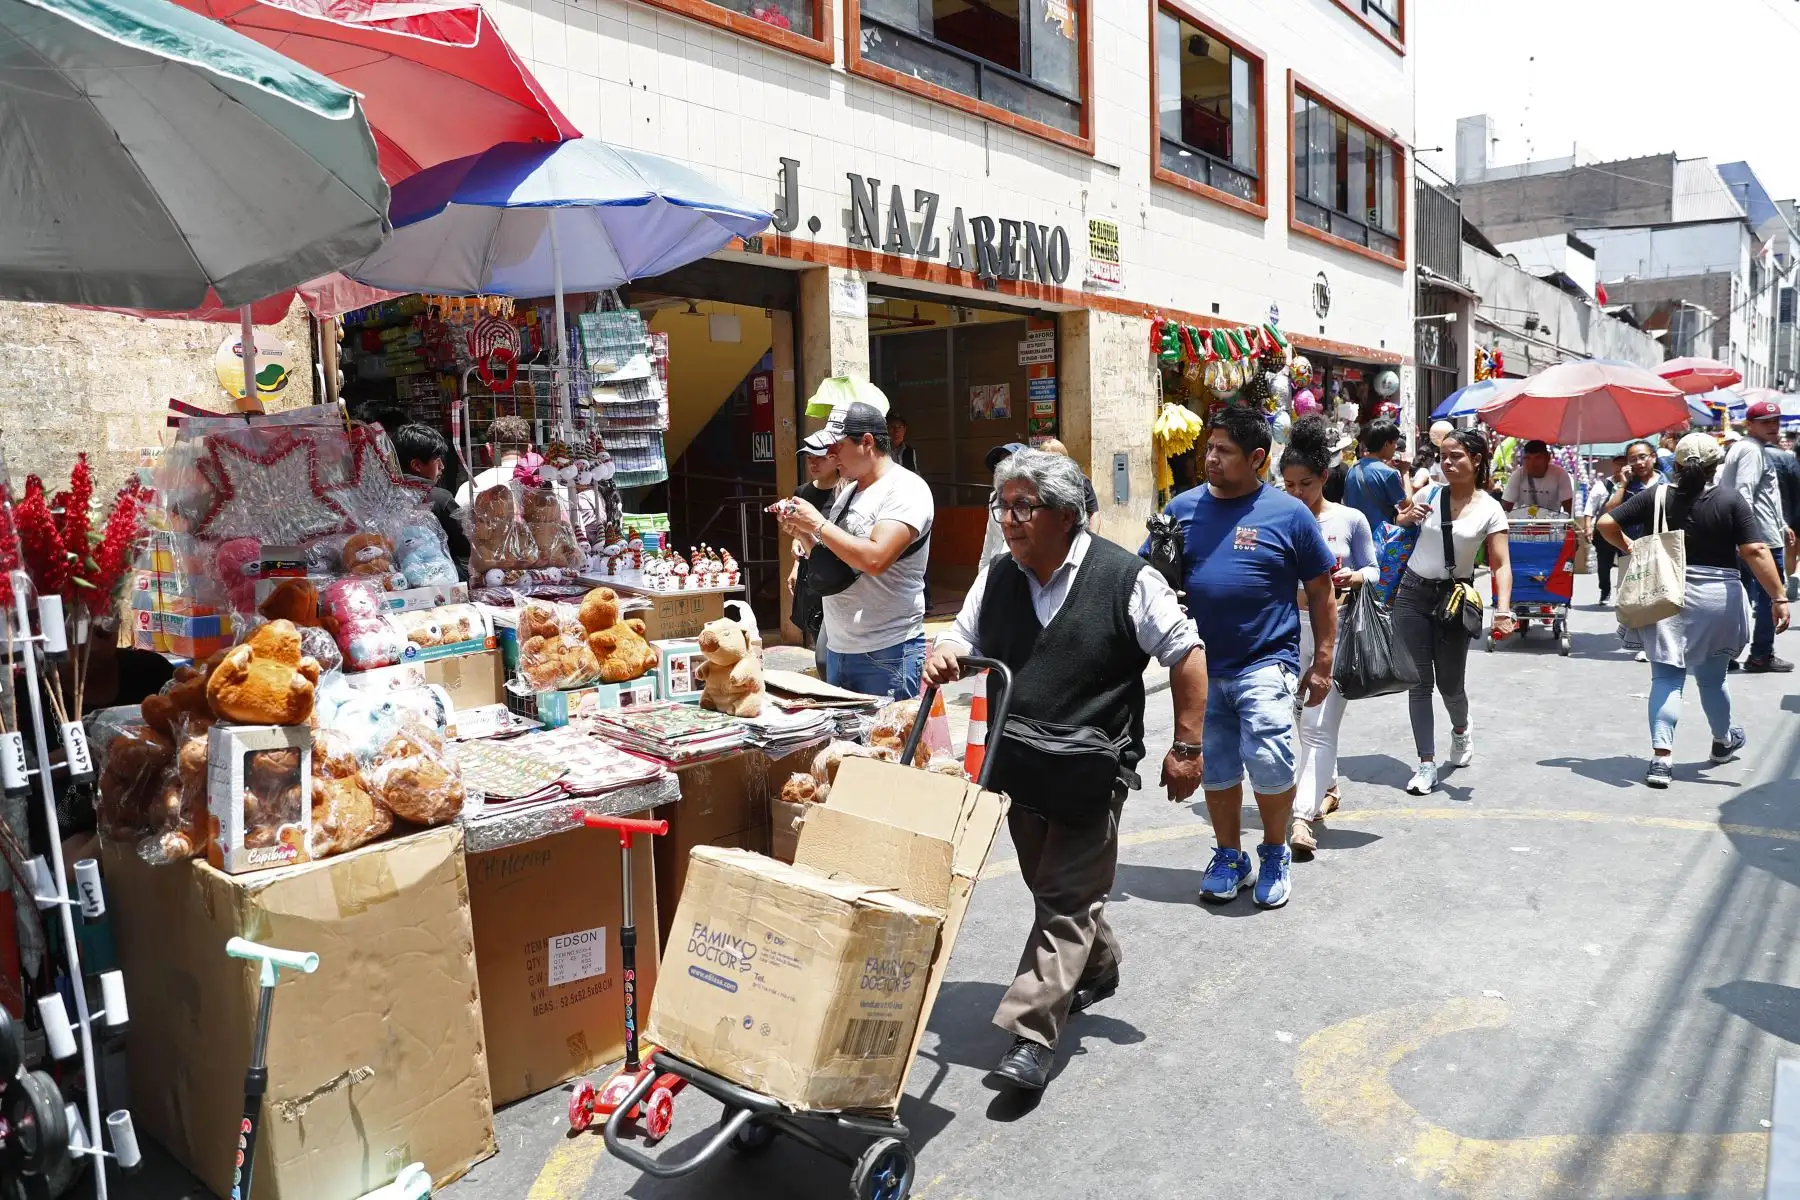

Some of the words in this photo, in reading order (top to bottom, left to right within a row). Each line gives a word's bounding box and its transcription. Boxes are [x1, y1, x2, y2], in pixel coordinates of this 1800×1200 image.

[847, 171, 1070, 285] NAZARENO
[247, 846, 298, 867] Capibara
[555, 931, 597, 949] EDSON
